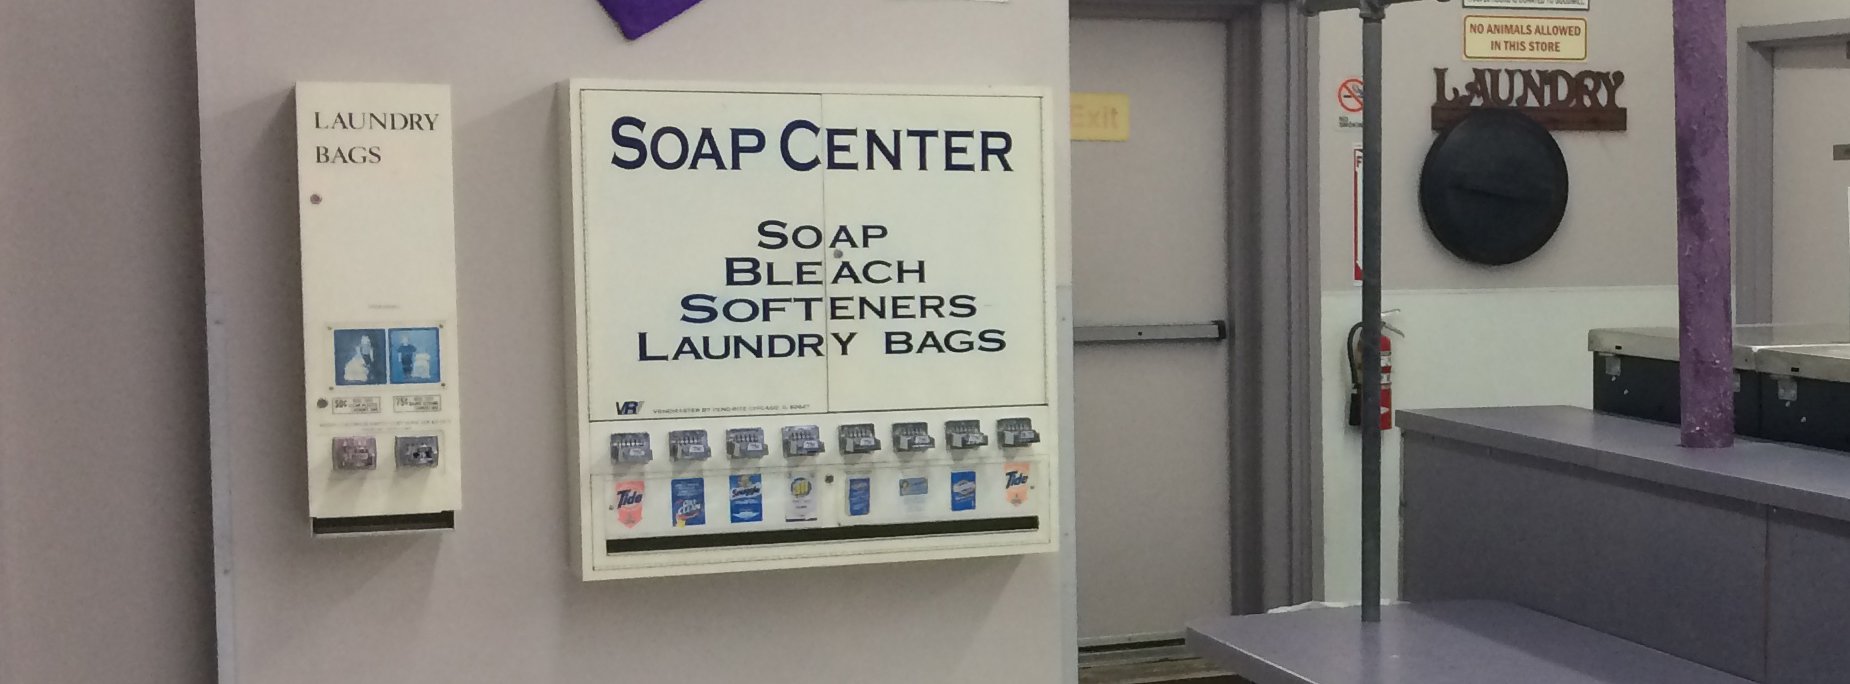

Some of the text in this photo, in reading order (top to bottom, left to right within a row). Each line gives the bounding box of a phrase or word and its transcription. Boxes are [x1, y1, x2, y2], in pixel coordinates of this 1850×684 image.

[1470, 24, 1581, 36] NO ANIMALS ALLOWED
[1491, 41, 1560, 52] IN THIS STORE
[1433, 67, 1625, 109] LAUNDRY
[314, 111, 439, 131] LAUNDRY
[315, 145, 382, 164] BAGS
[611, 116, 1014, 172] SOAP CENTER
[757, 220, 888, 250] SOAP
[724, 256, 926, 287] BLEACH
[679, 293, 978, 324] SOFTENERS
[638, 329, 1007, 362] LAUNDRY BAGS
[1006, 470, 1029, 489] Tide
[616, 489, 643, 510] Tide
